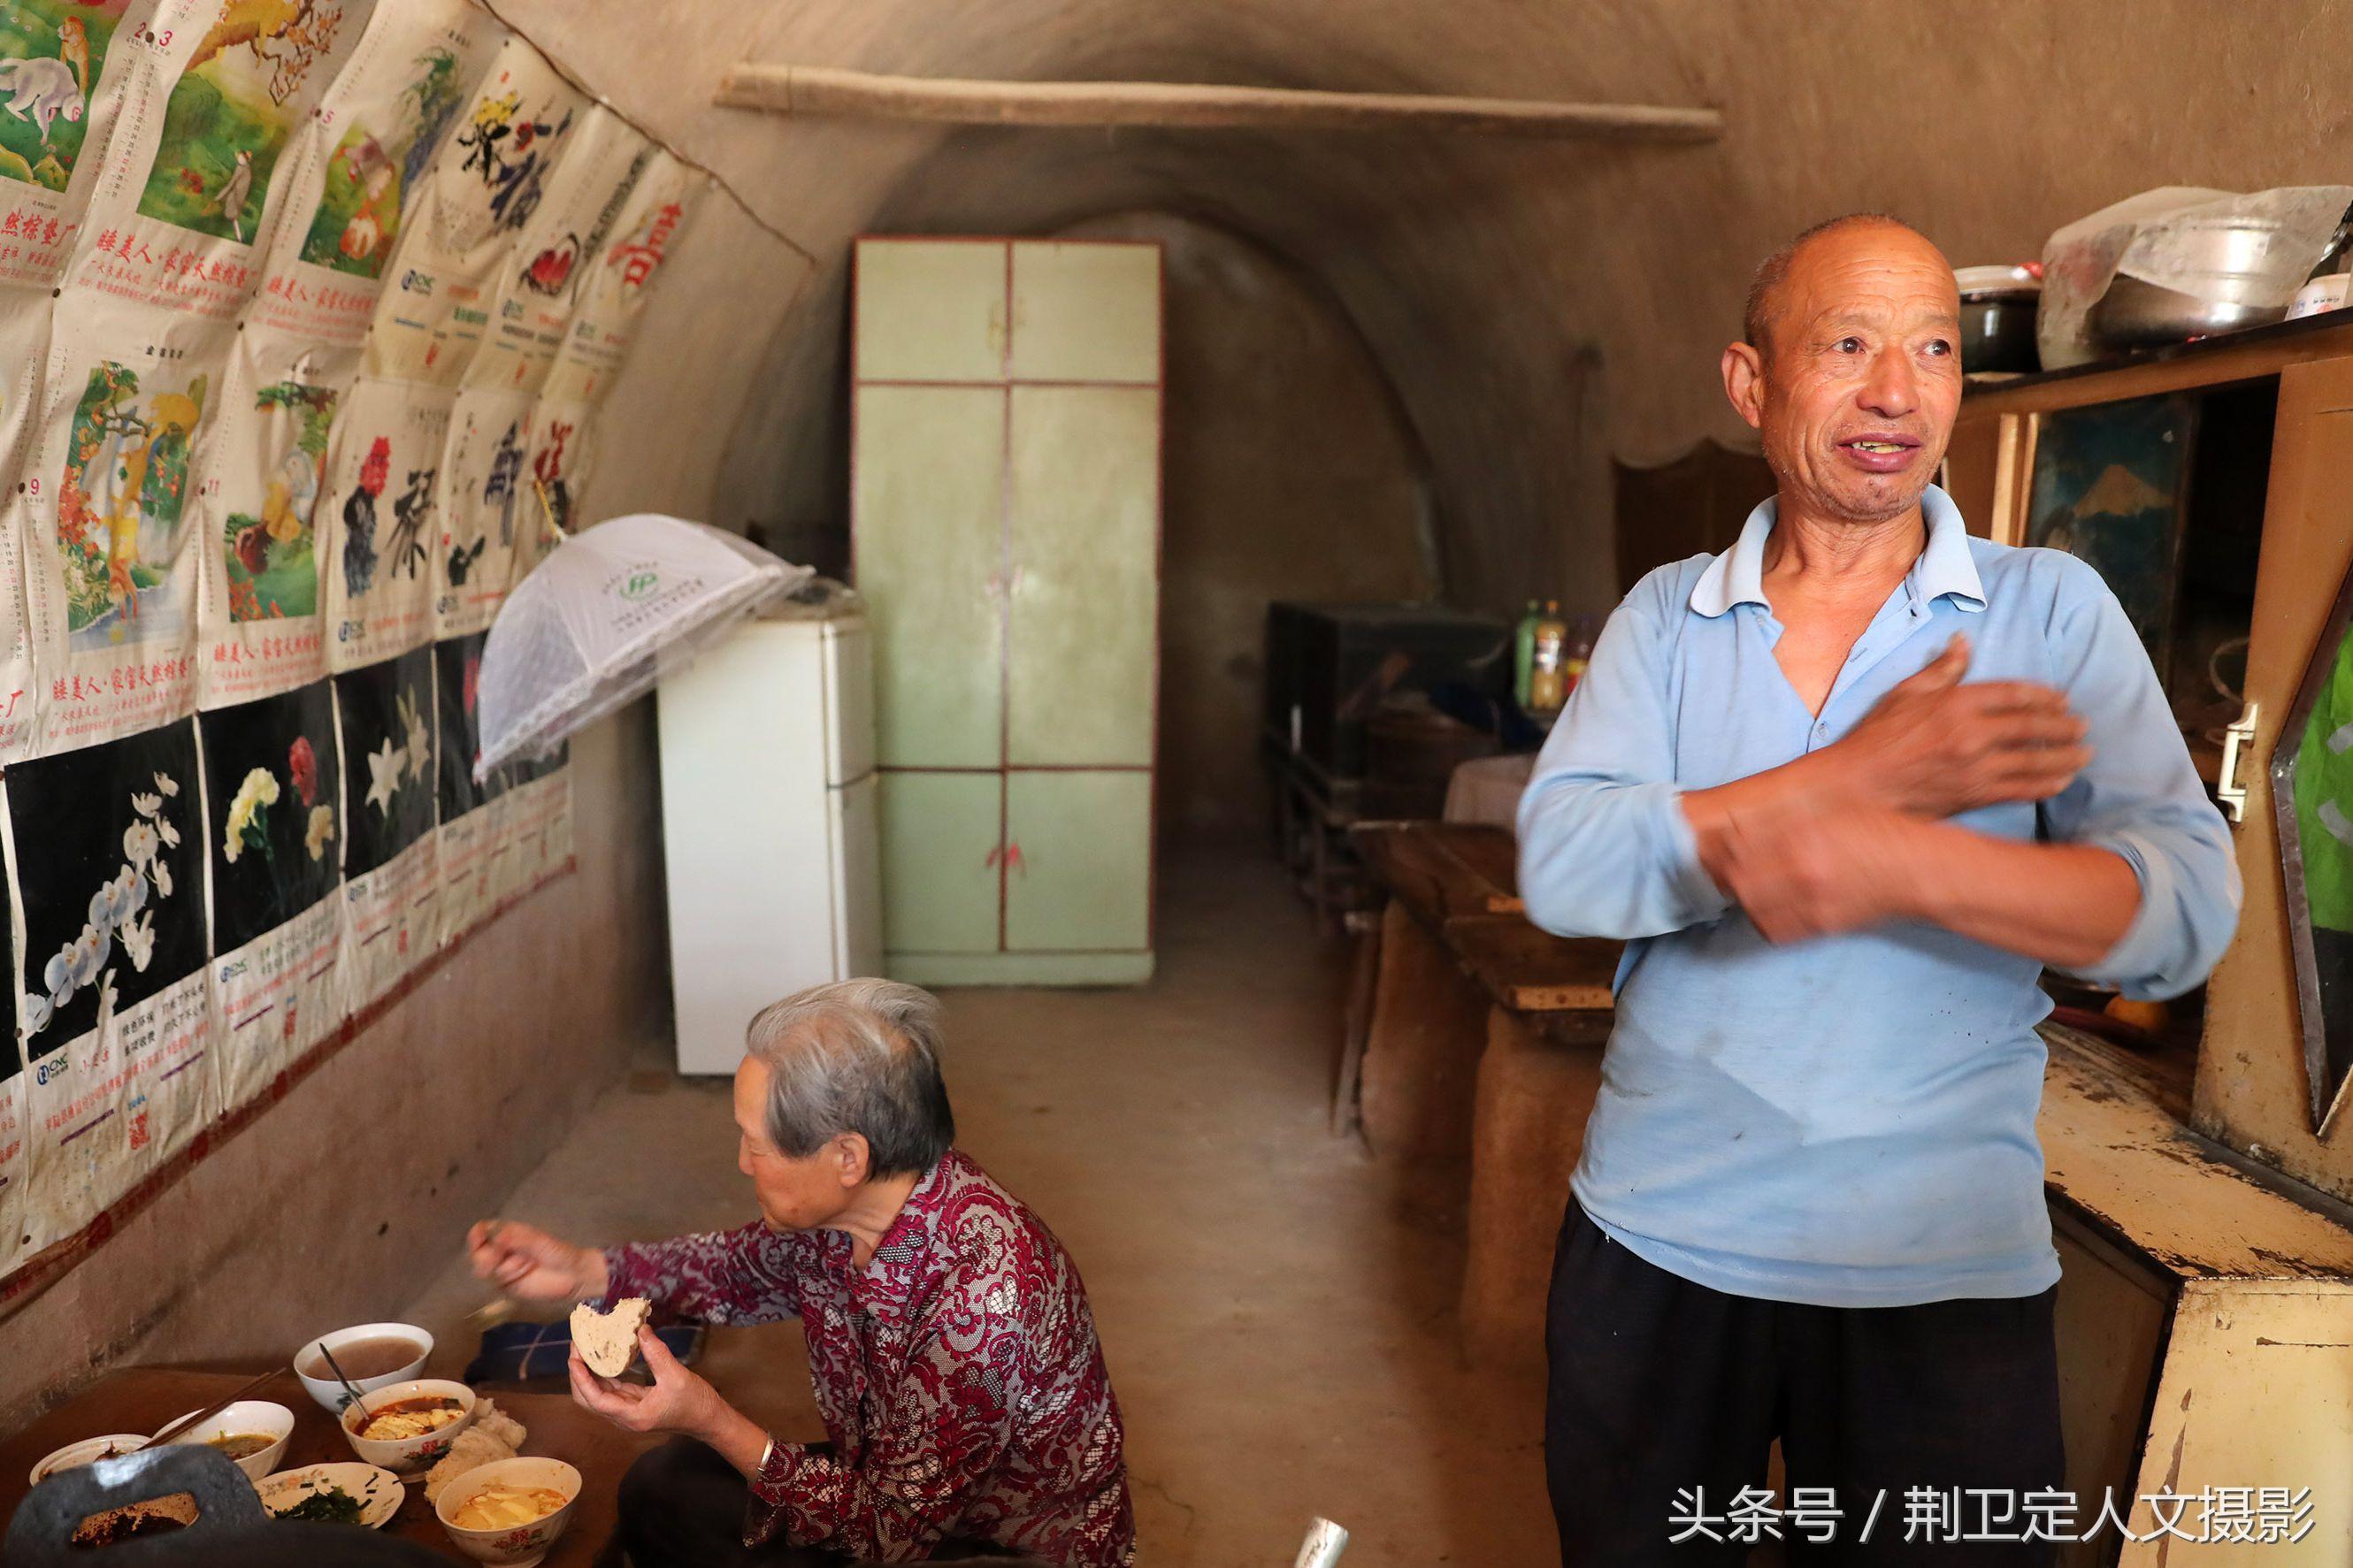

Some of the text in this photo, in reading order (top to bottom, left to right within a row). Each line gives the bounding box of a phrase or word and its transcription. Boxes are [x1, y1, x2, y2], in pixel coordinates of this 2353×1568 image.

[134, 22, 146, 39] 2
[159, 30, 172, 46] 3
[30, 478, 40, 495] 9
